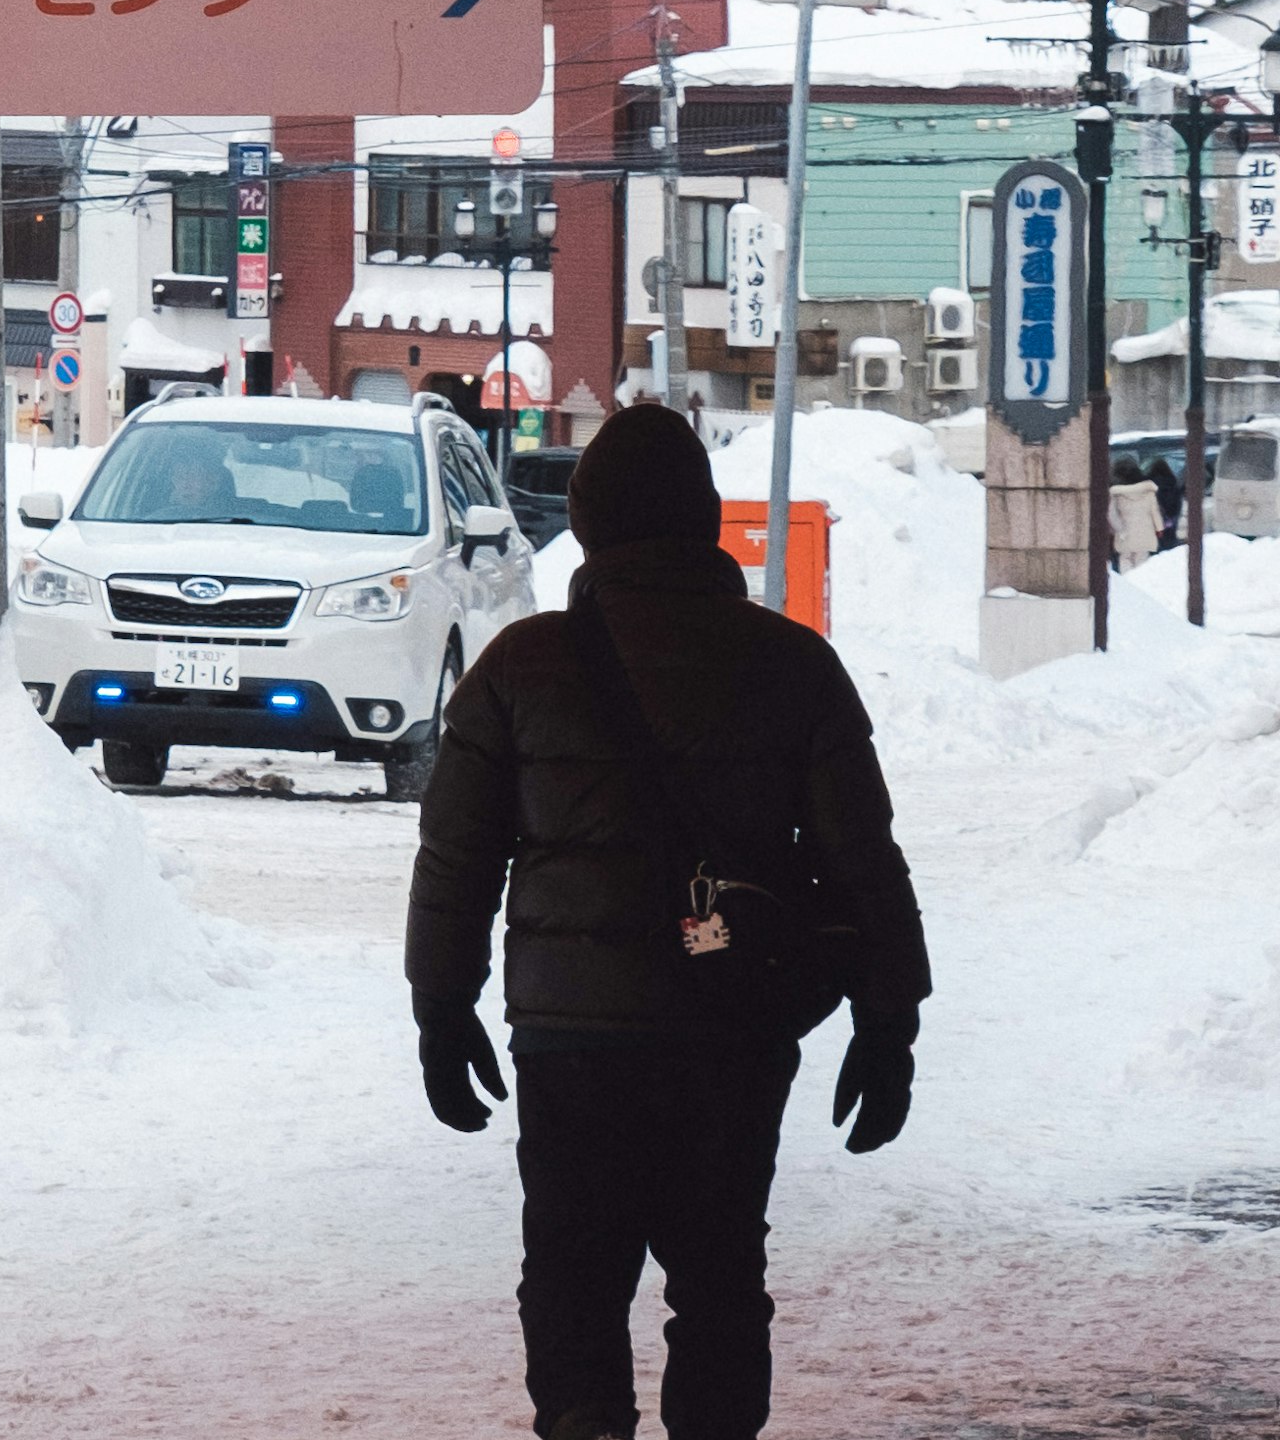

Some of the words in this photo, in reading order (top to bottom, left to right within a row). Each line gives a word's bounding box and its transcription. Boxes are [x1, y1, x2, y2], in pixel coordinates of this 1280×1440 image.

[1248, 159, 1276, 236] 北一硝子
[58, 304, 77, 322] 30
[174, 663, 234, 686] 21-16
